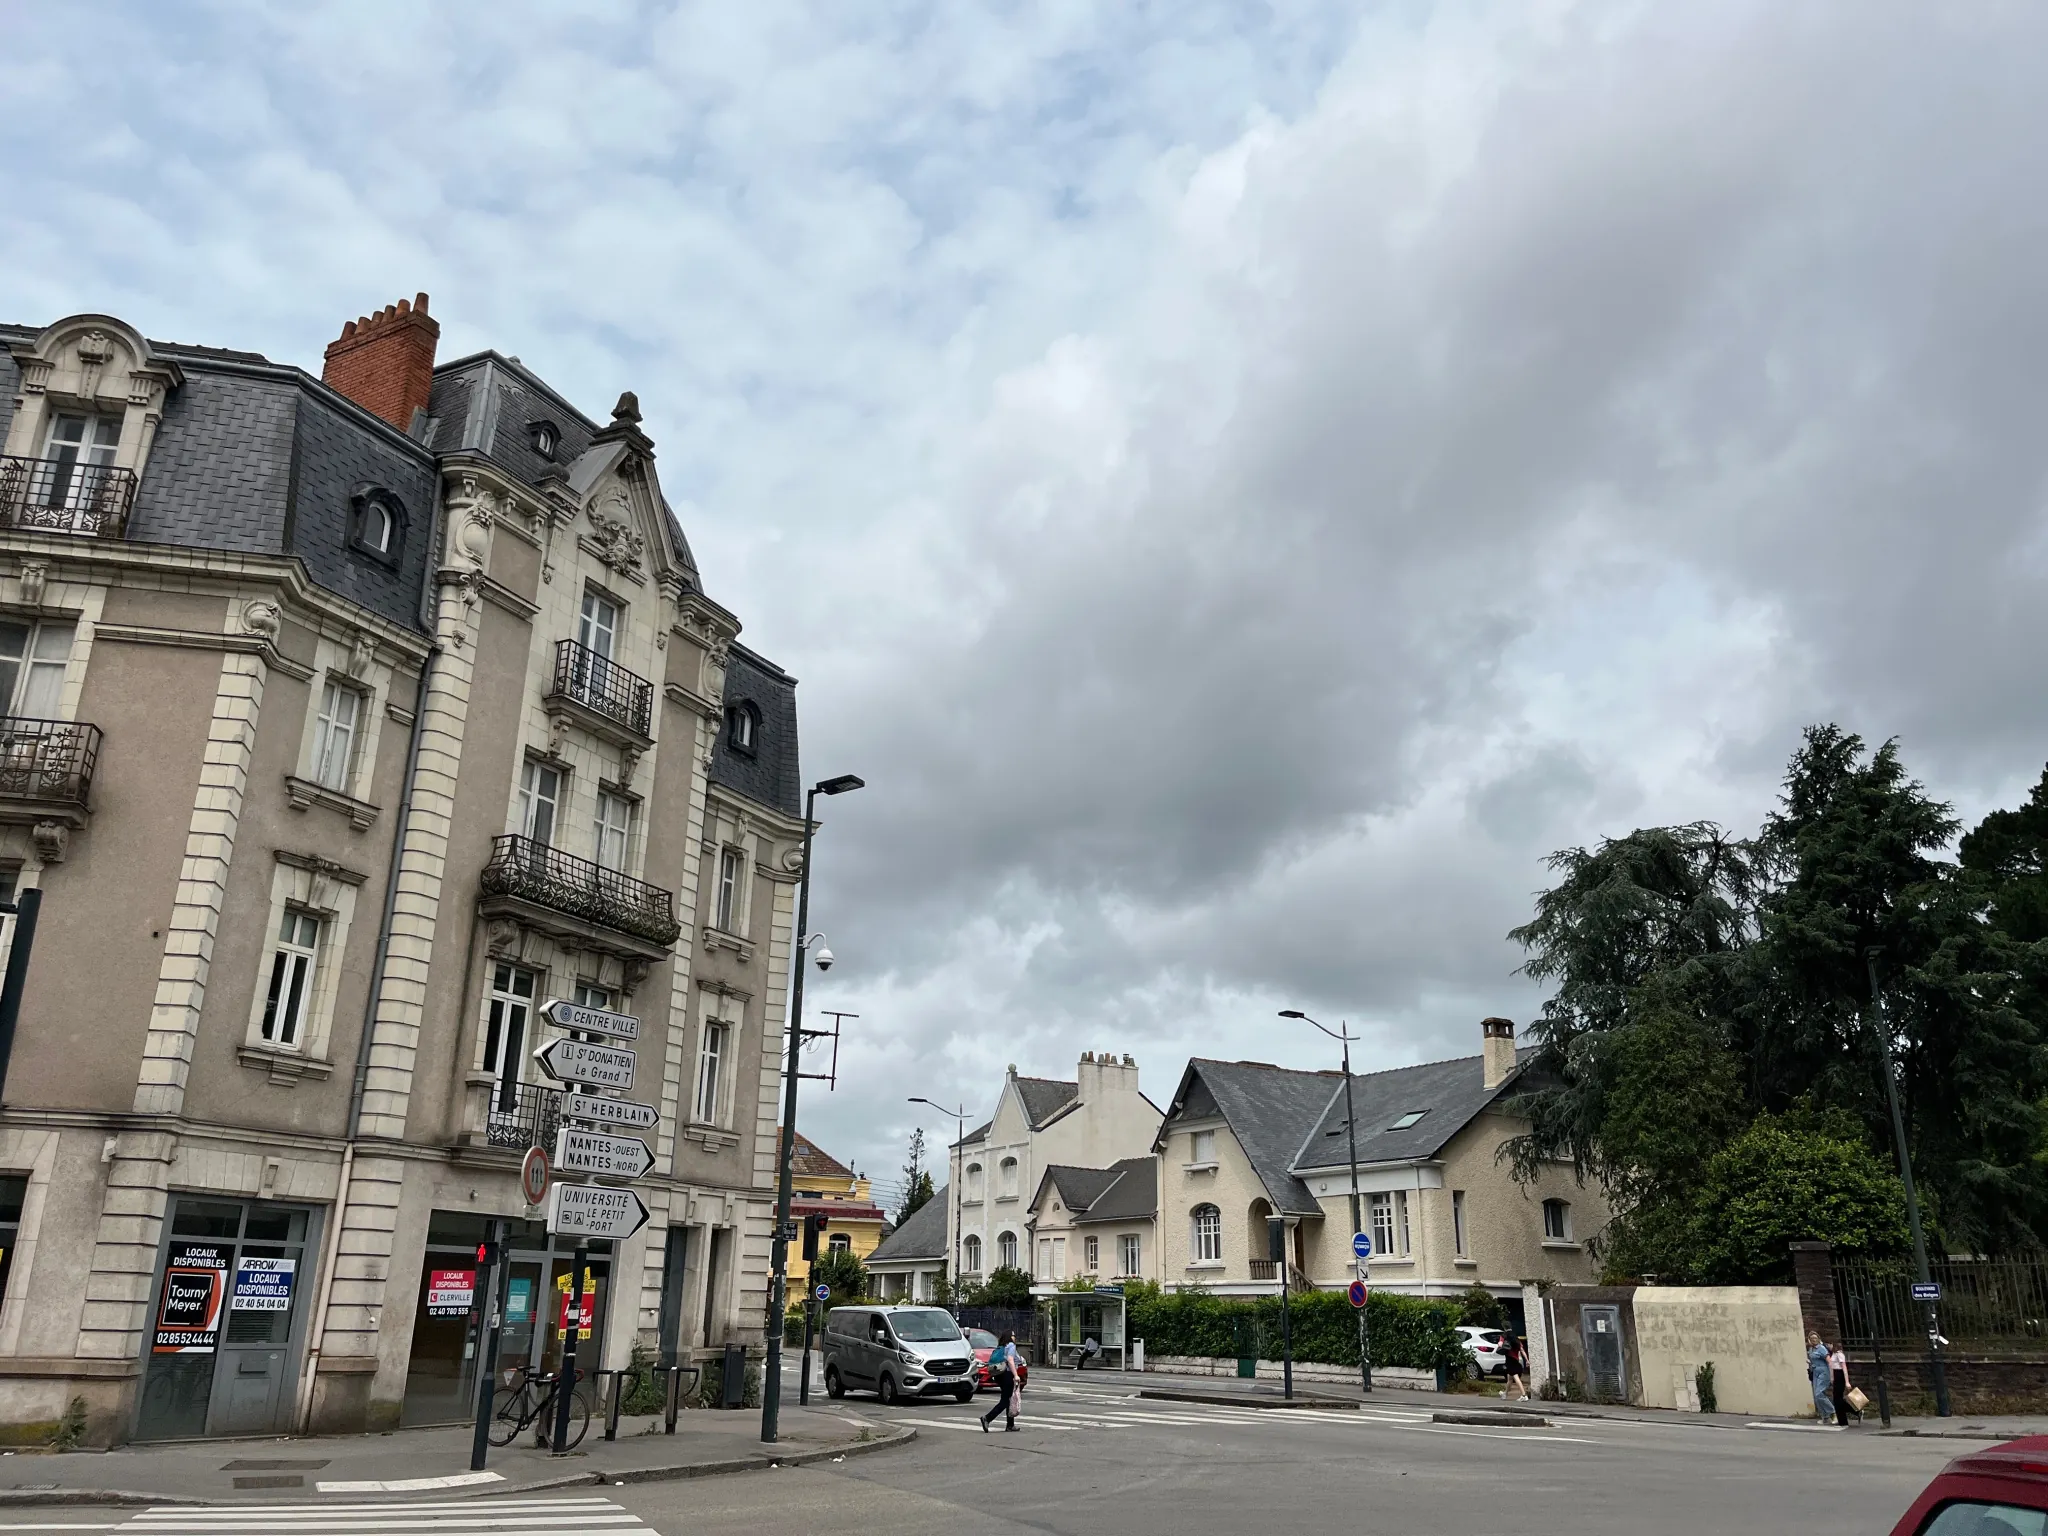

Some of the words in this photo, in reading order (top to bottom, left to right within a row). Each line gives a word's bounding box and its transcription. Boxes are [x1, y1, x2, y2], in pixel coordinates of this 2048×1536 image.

[574, 1010, 609, 1029] CENTRE
[612, 1019, 636, 1034] VILLE
[588, 1052, 632, 1068] DONATIEN
[575, 1064, 587, 1076] Le
[591, 1067, 621, 1082] Grand
[624, 1072, 631, 1084] T
[591, 1104, 650, 1123] HERBLAIN
[564, 1190, 629, 1208] UNIVERSITÉ
[587, 1207, 598, 1218] LE
[600, 1209, 625, 1221] PETIT
[586, 1220, 613, 1232] -PORT
[186, 1248, 218, 1258] LOCAUX
[174, 1258, 226, 1268] DISPONIBLES
[242, 1260, 278, 1270] ARROW
[250, 1274, 280, 1284] LOCAUX
[172, 1285, 208, 1300] Tourny
[237, 1284, 288, 1296] DISPONIBLES
[235, 1299, 244, 1308] 02
[245, 1299, 254, 1308] 40
[256, 1299, 265, 1308] 54
[266, 1299, 276, 1308] 04
[277, 1299, 286, 1308] 04
[440, 1294, 470, 1302] CLERVILLE
[579, 1314, 592, 1326] oyd
